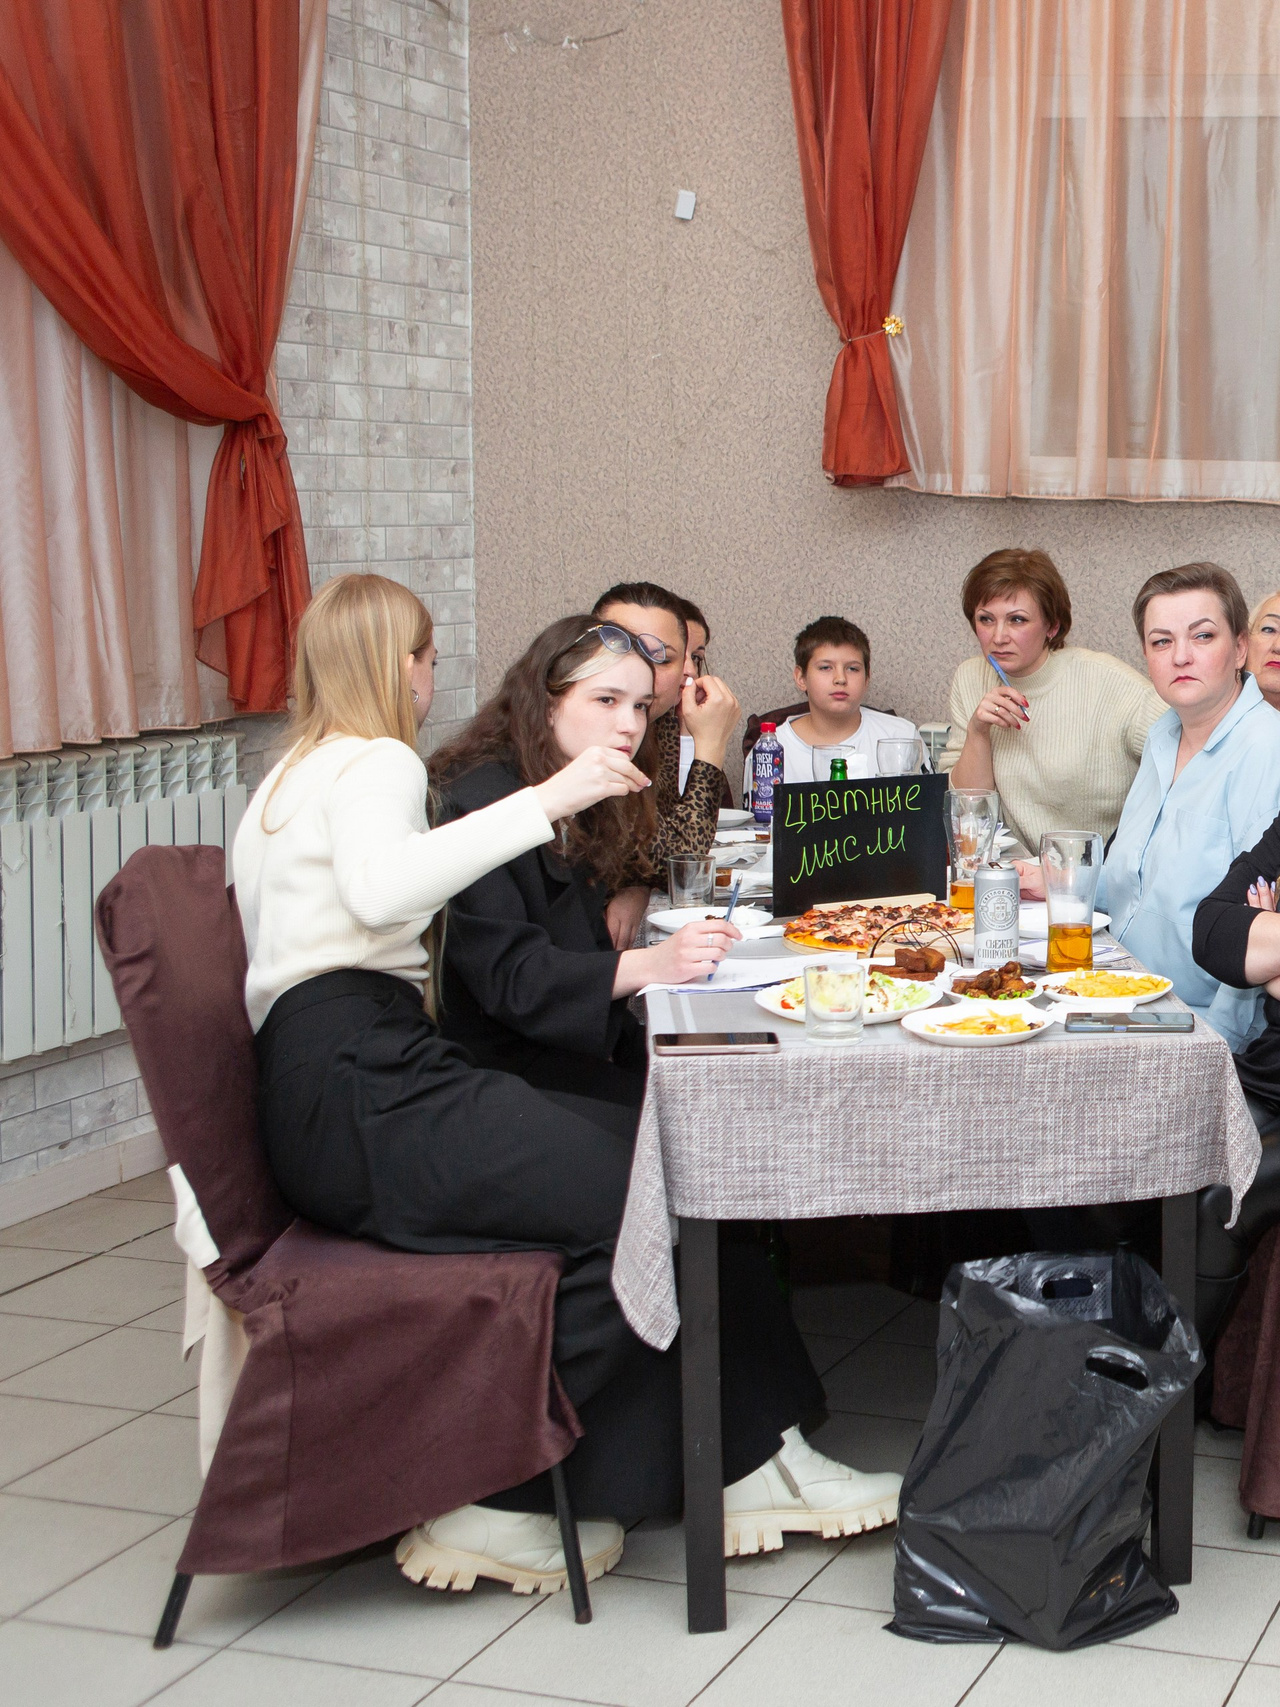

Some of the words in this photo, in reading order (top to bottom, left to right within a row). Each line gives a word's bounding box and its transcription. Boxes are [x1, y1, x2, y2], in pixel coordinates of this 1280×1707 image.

[755, 753, 773, 764] FRESH
[755, 764, 773, 778] BAR
[784, 784, 922, 834] Цветные
[982, 889, 1006, 904] СВЕТЛОЕ
[1006, 890, 1018, 904] ПИВО
[985, 938, 1015, 949] СВЕЖЕЕ
[977, 947, 982, 958] С
